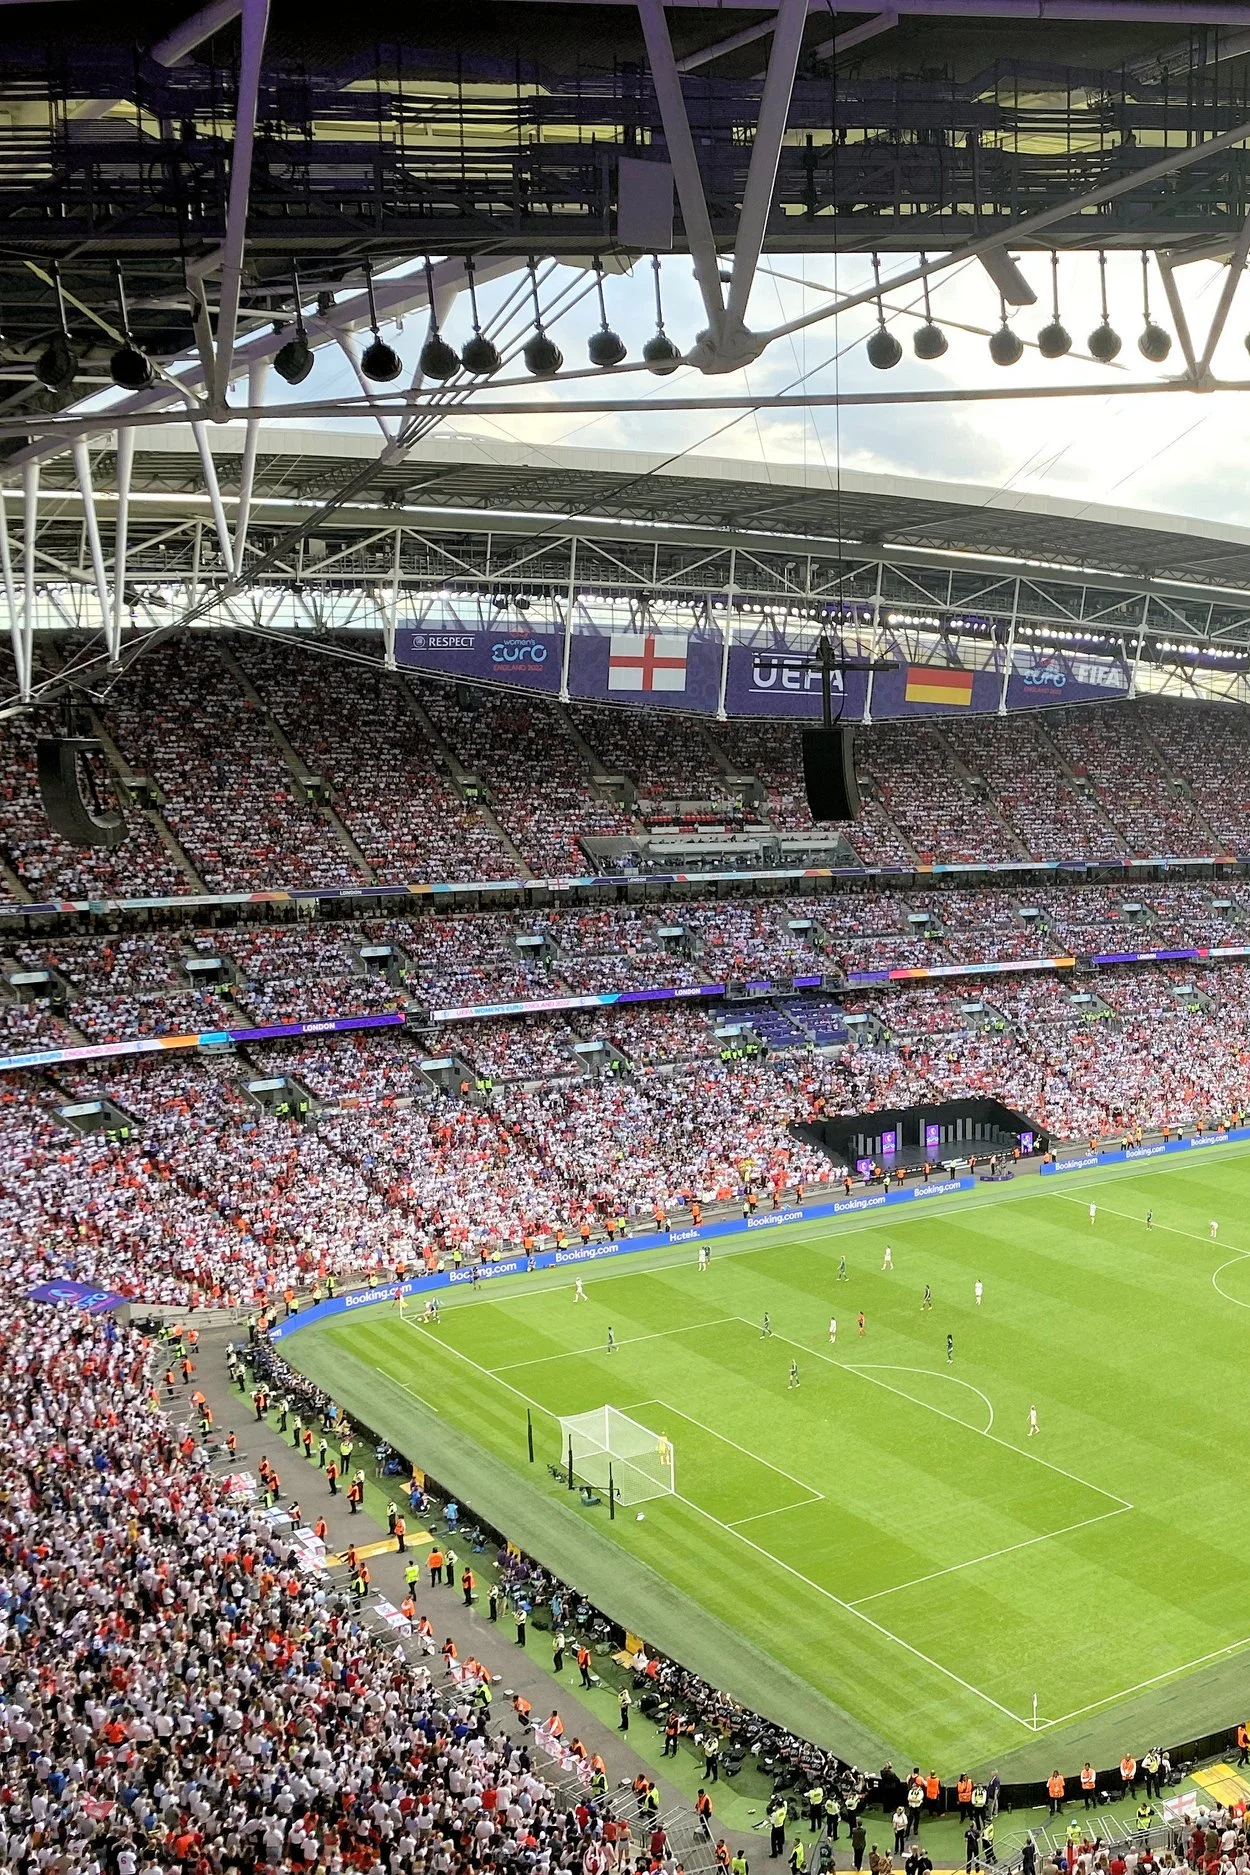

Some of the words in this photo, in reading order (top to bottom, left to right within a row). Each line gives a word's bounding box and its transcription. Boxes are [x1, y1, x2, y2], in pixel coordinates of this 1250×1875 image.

[428, 636, 475, 647] RESPECT
[753, 657, 844, 691] UEFA
[1079, 664, 1120, 687] FIFA
[675, 988, 701, 996] LONDON
[302, 1022, 335, 1032] LONDON
[1190, 1133, 1229, 1147] Booking.com
[1126, 1144, 1166, 1159] Booking.com
[1055, 1156, 1098, 1171] Booking.com
[914, 1180, 961, 1198] Booking.com
[834, 1195, 886, 1212] Booking.com
[747, 1210, 803, 1228] Booking.com
[669, 1229, 701, 1242] Hotels.
[555, 1243, 619, 1263] Booking.com
